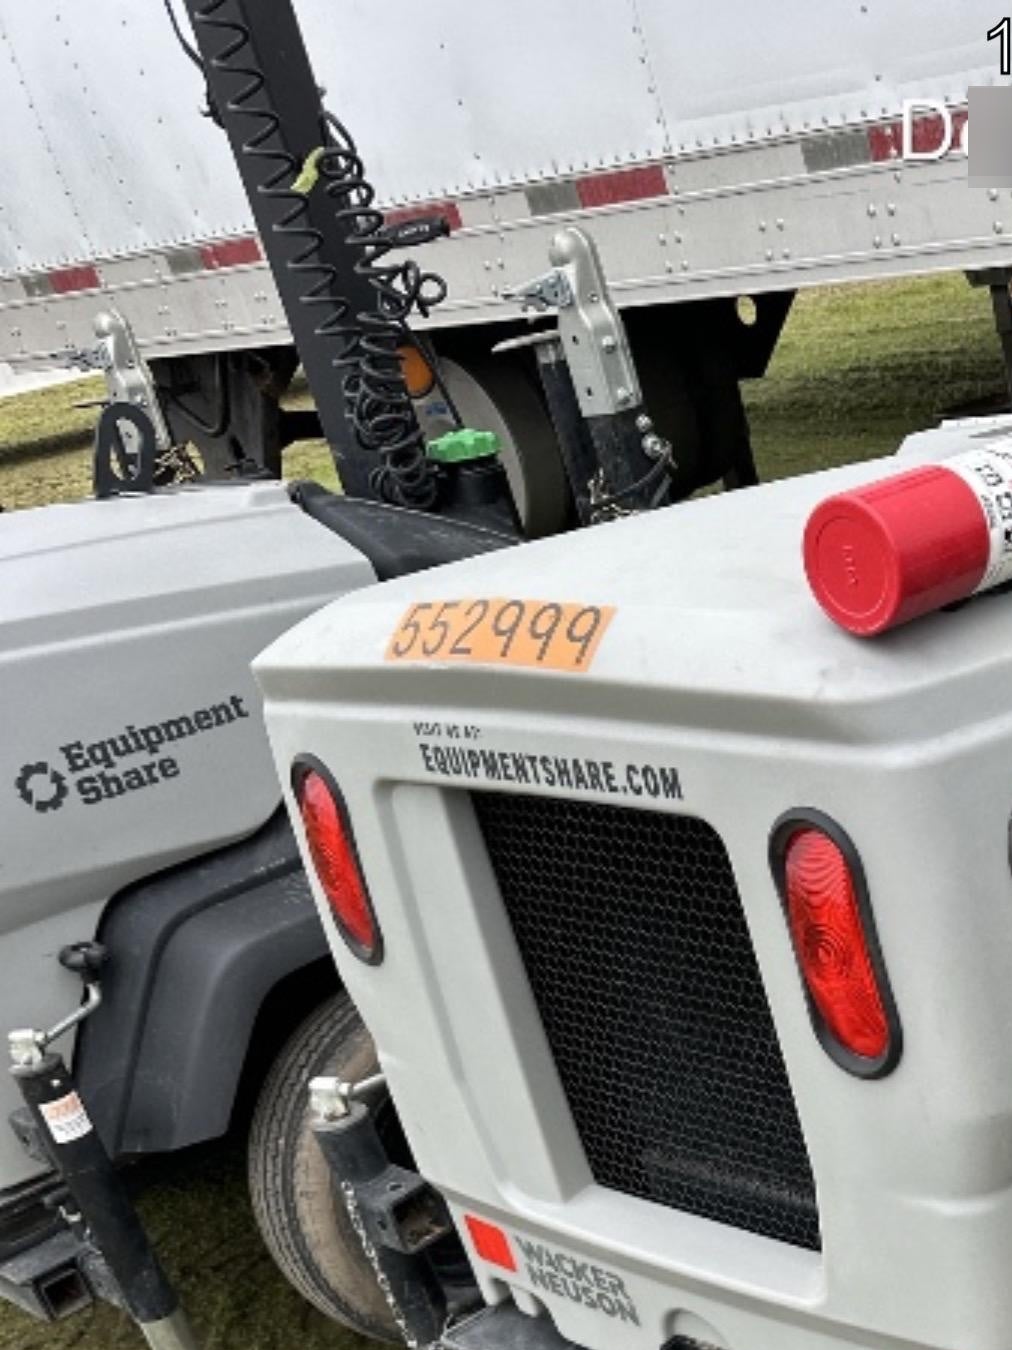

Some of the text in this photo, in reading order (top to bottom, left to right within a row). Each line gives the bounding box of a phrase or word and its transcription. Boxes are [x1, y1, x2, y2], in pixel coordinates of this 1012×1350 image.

[393, 600, 601, 664] 552999
[59, 695, 249, 773] Equipment
[76, 756, 180, 805] Share
[418, 743, 684, 799] EQUIPMENTSHARE.COM
[515, 1234, 632, 1302] WACKER
[526, 1264, 641, 1326] NEUSON
